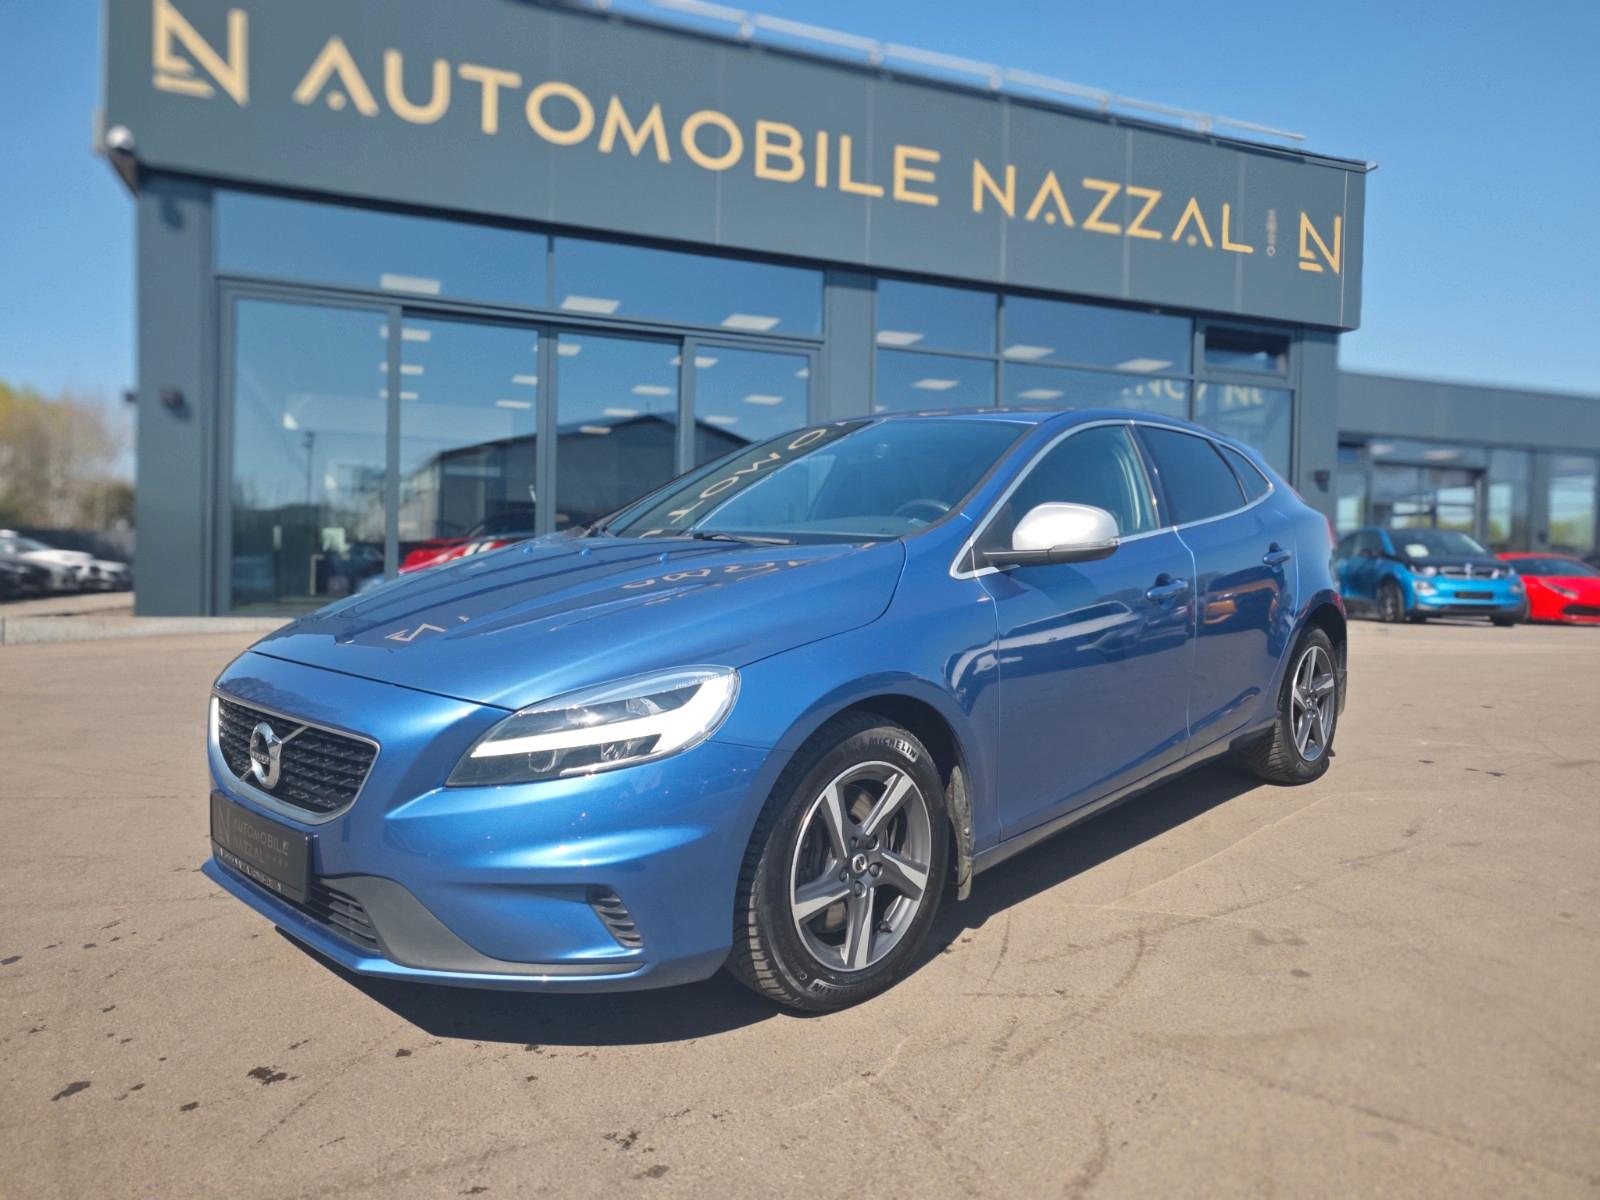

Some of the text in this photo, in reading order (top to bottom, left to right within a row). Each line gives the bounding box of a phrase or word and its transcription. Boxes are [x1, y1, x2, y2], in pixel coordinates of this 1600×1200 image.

[294, 39, 941, 207] AUTOMOBILE
[971, 159, 1254, 255] NAZZAL
[868, 736, 918, 760] MICHELIN
